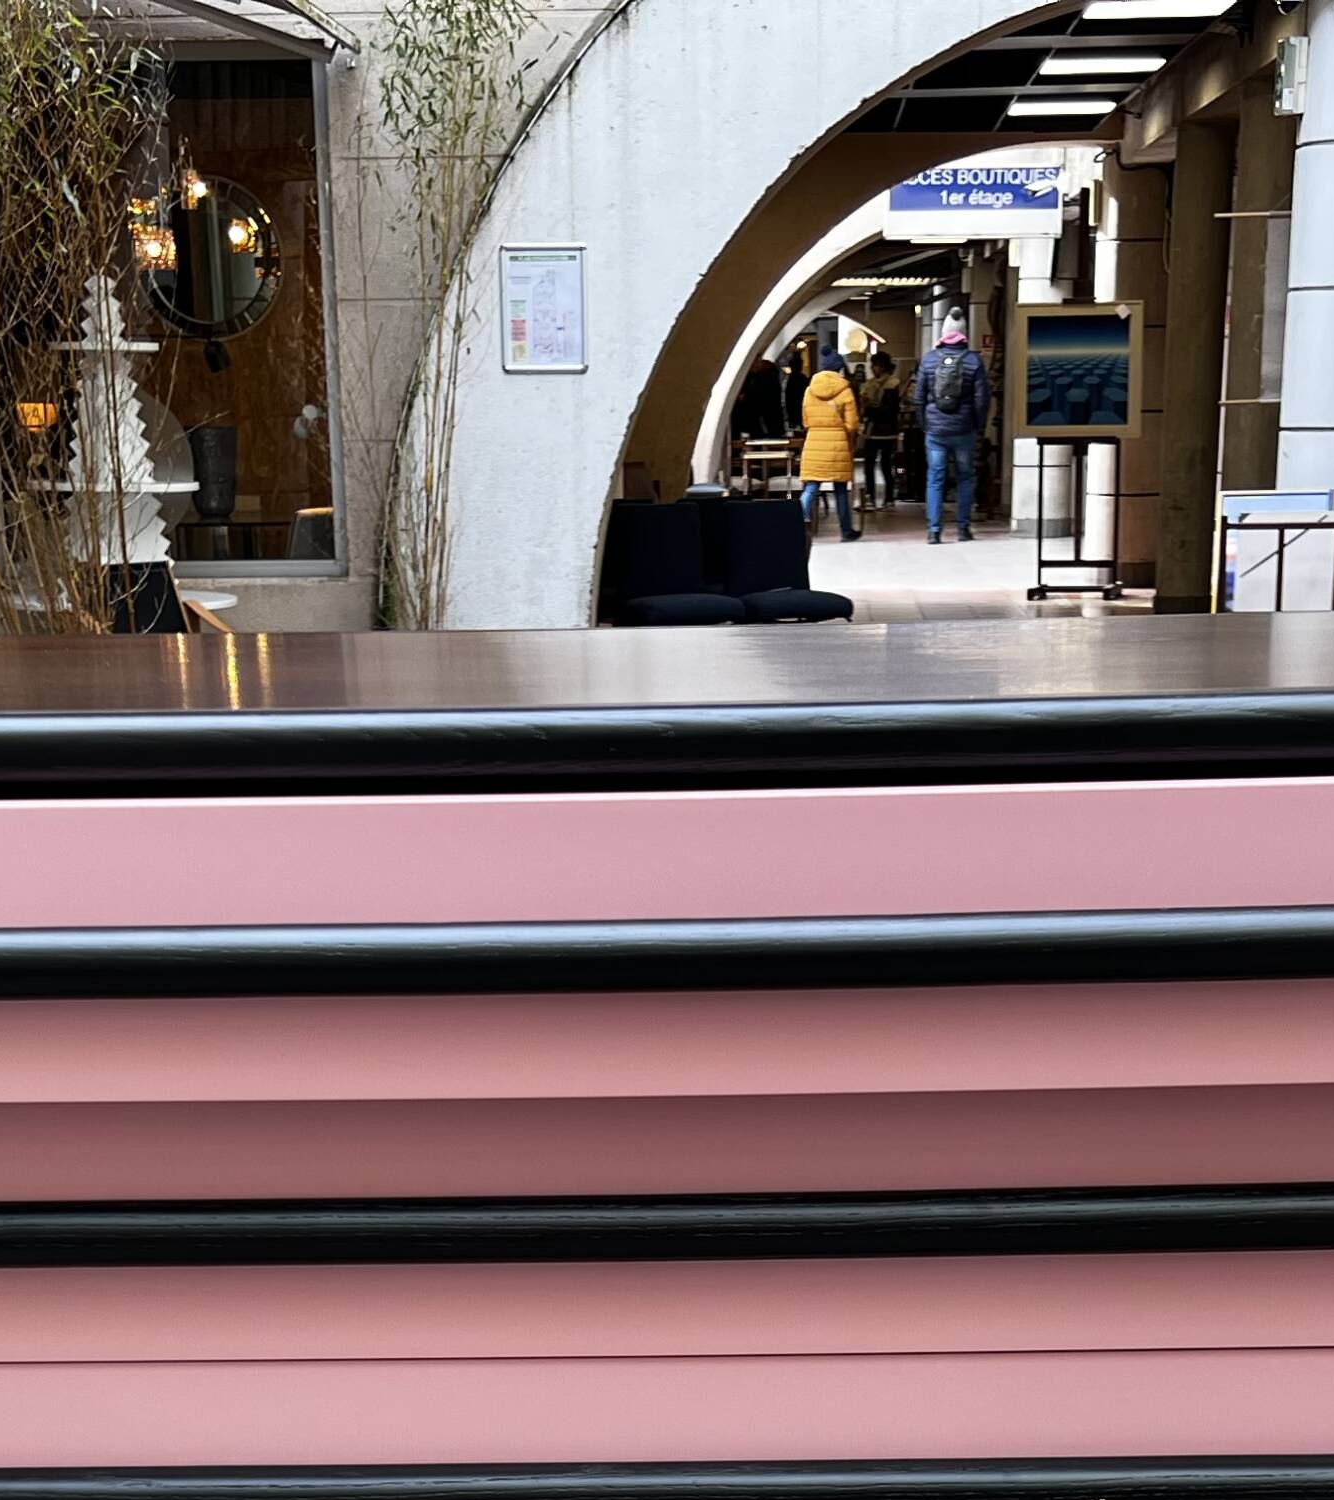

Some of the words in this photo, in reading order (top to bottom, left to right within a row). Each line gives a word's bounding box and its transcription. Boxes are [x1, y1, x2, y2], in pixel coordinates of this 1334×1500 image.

[902, 169, 954, 185] CES
[957, 169, 1057, 185] BOUTIQUES
[940, 190, 966, 205] 1er
[968, 188, 1014, 208] étage
